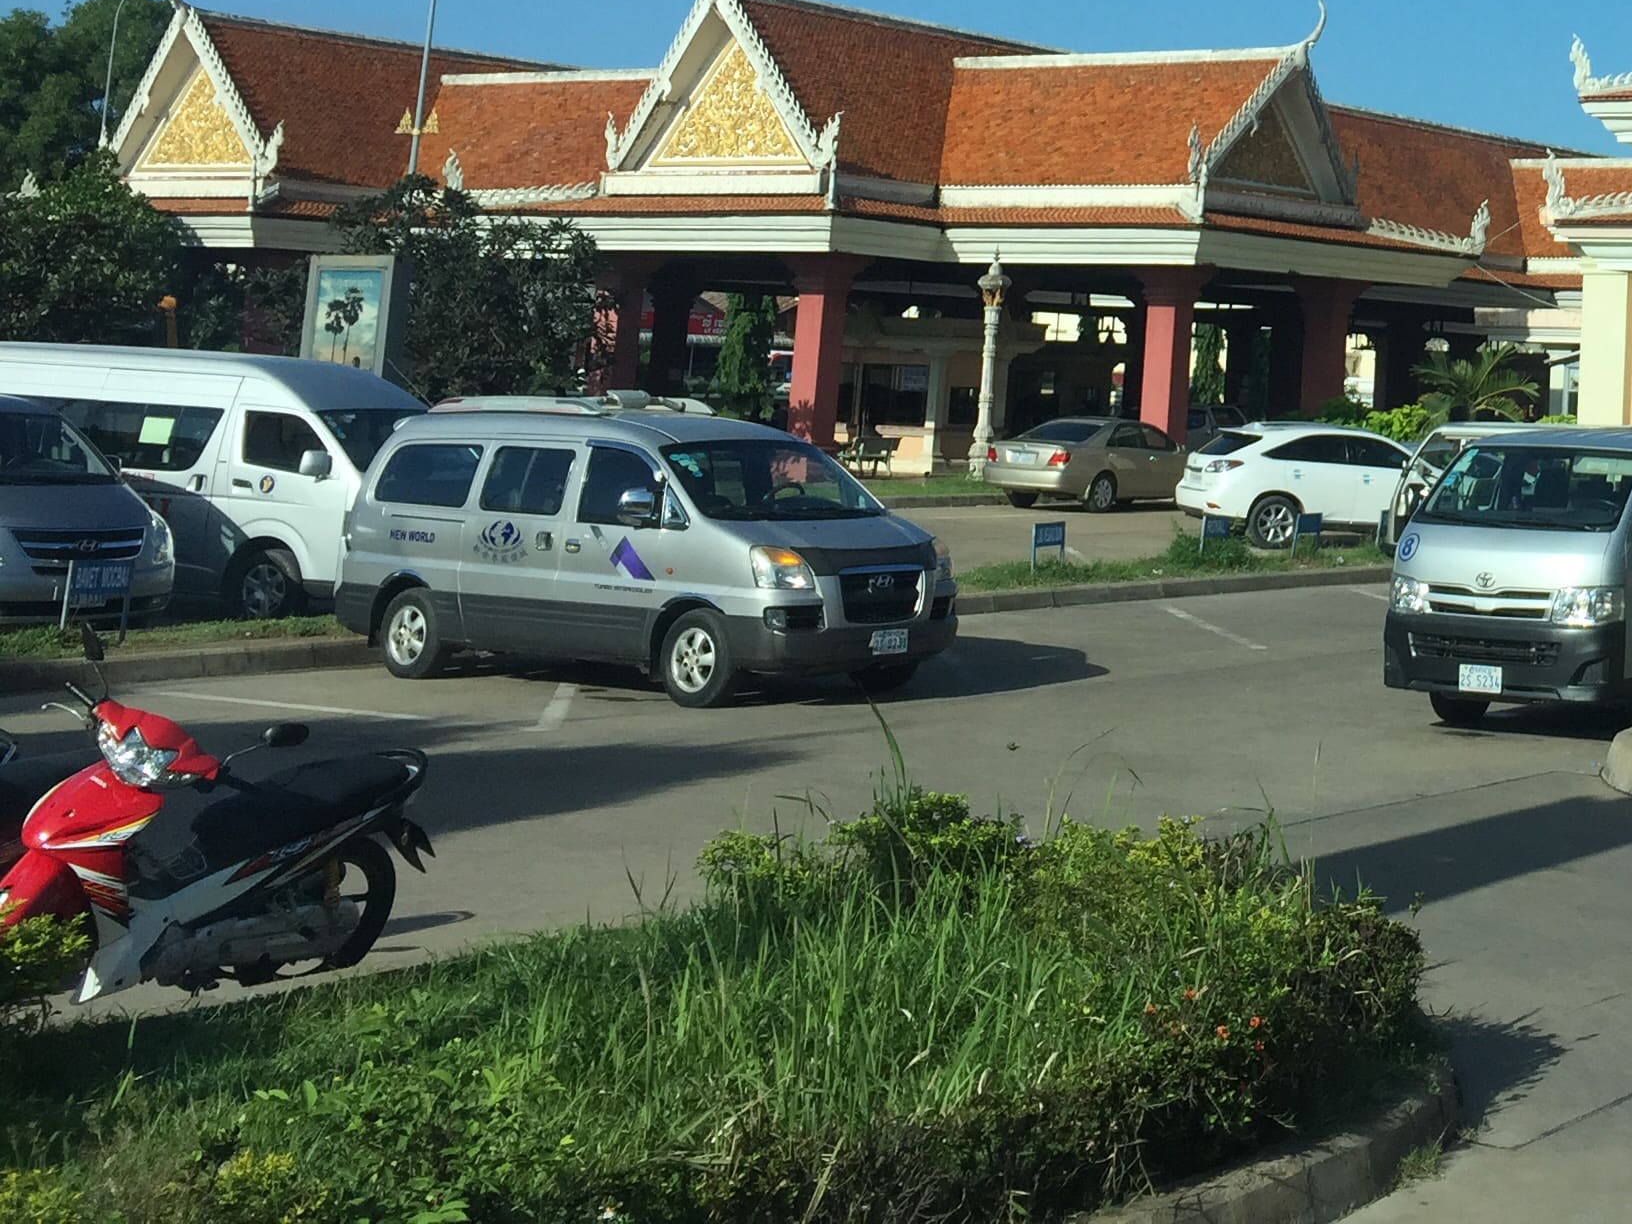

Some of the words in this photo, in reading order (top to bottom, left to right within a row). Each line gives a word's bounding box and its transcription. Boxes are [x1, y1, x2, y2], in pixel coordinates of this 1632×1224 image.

[390, 529, 407, 540] NEW
[408, 531, 435, 543] WORLD
[1402, 537, 1415, 556] 8
